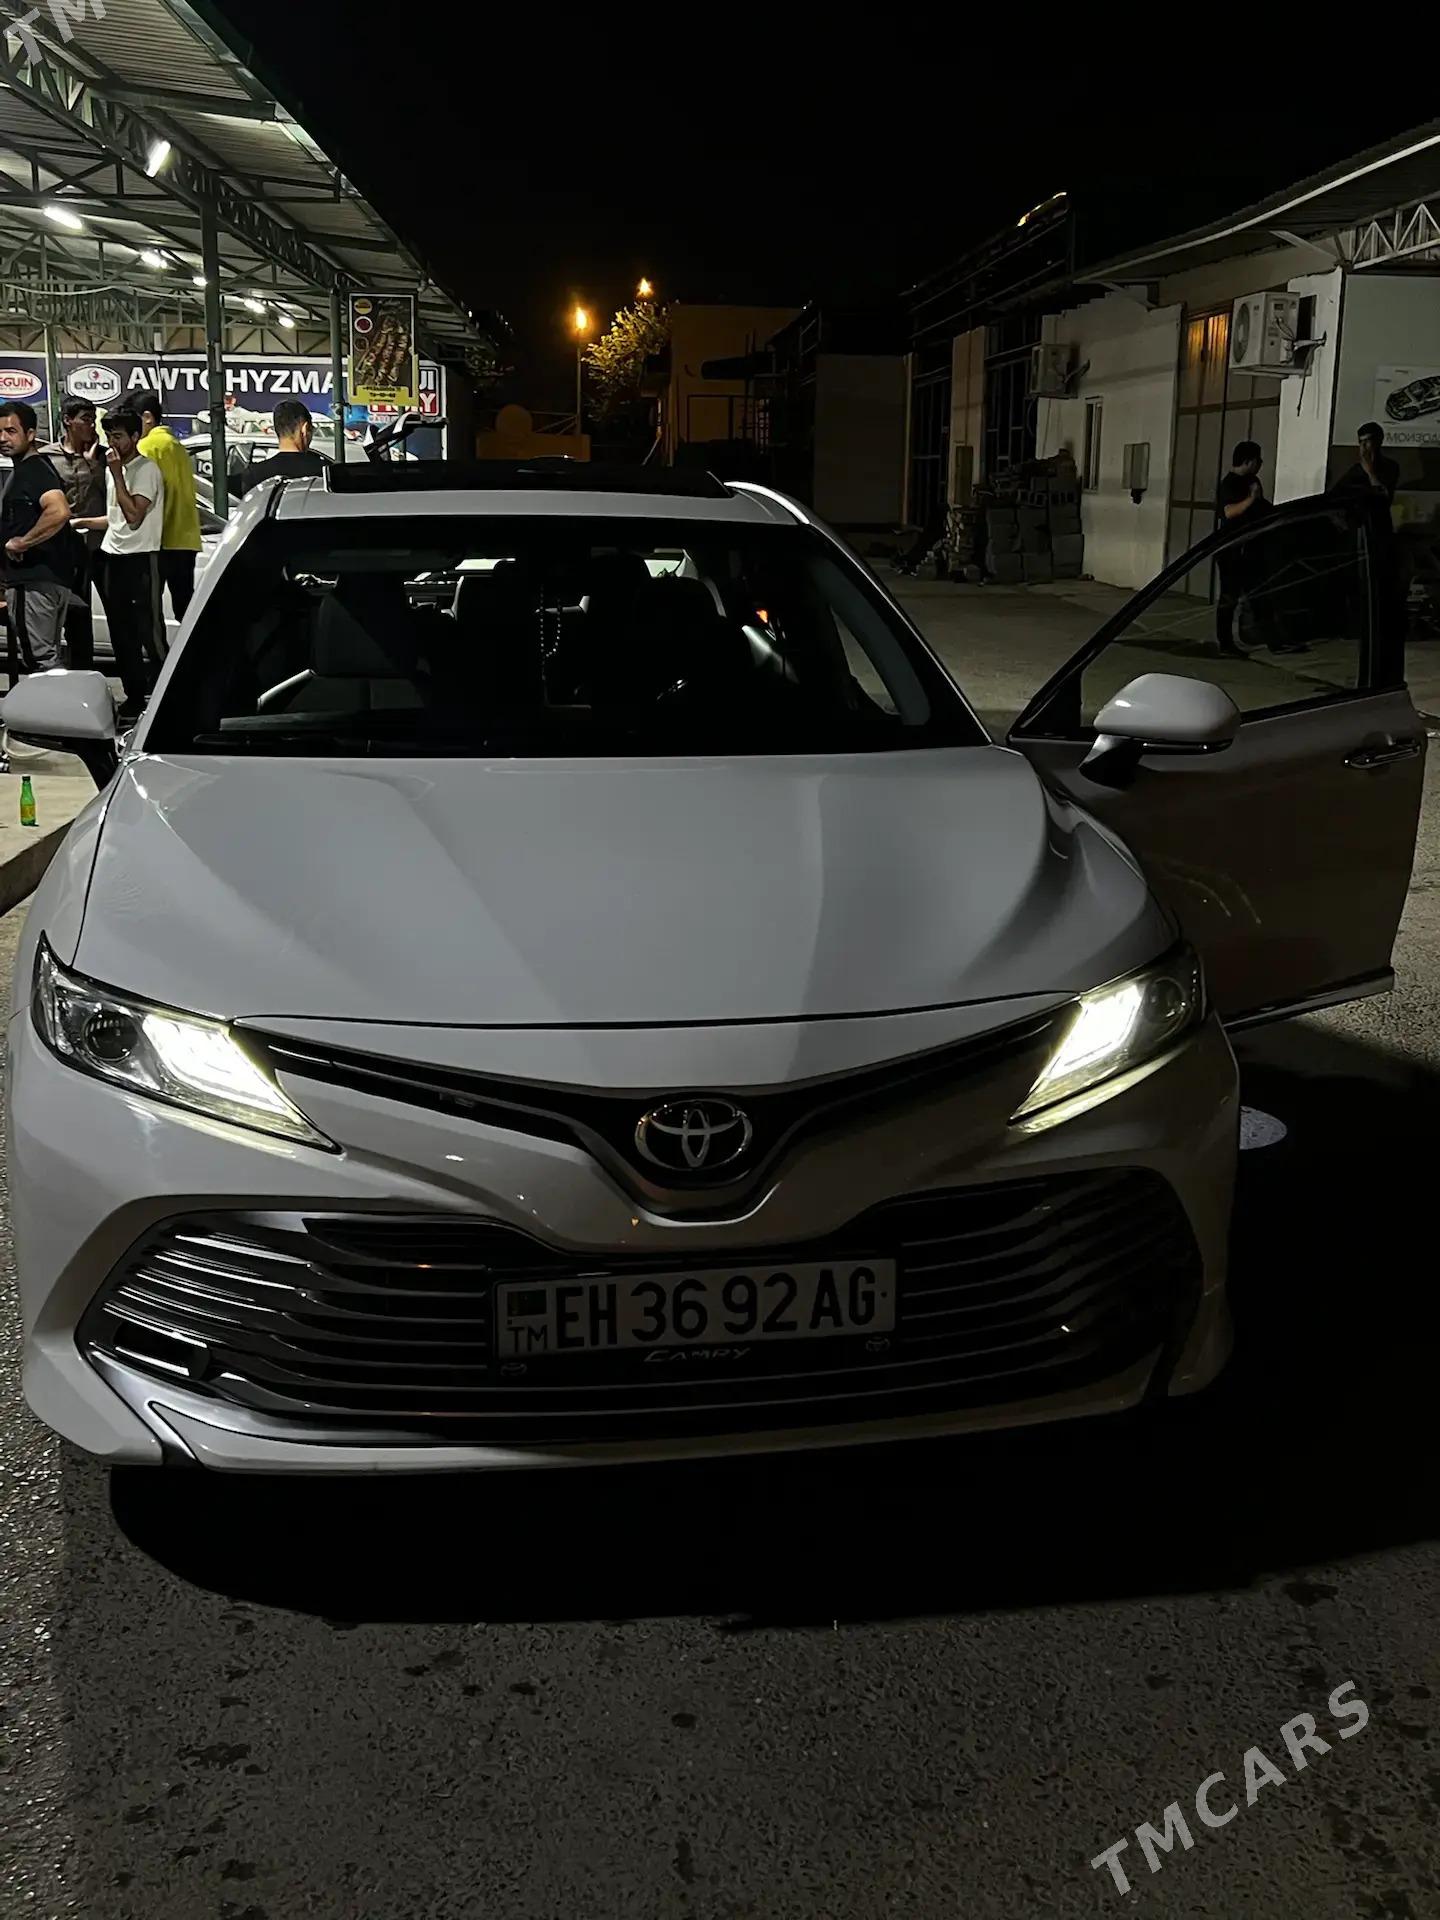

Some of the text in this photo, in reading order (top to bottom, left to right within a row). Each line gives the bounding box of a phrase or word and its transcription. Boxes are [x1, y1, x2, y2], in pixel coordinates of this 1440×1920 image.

[74, 380, 114, 390] eurol
[507, 1324, 548, 1354] TM
[643, 1347, 752, 1362] CAMRY
